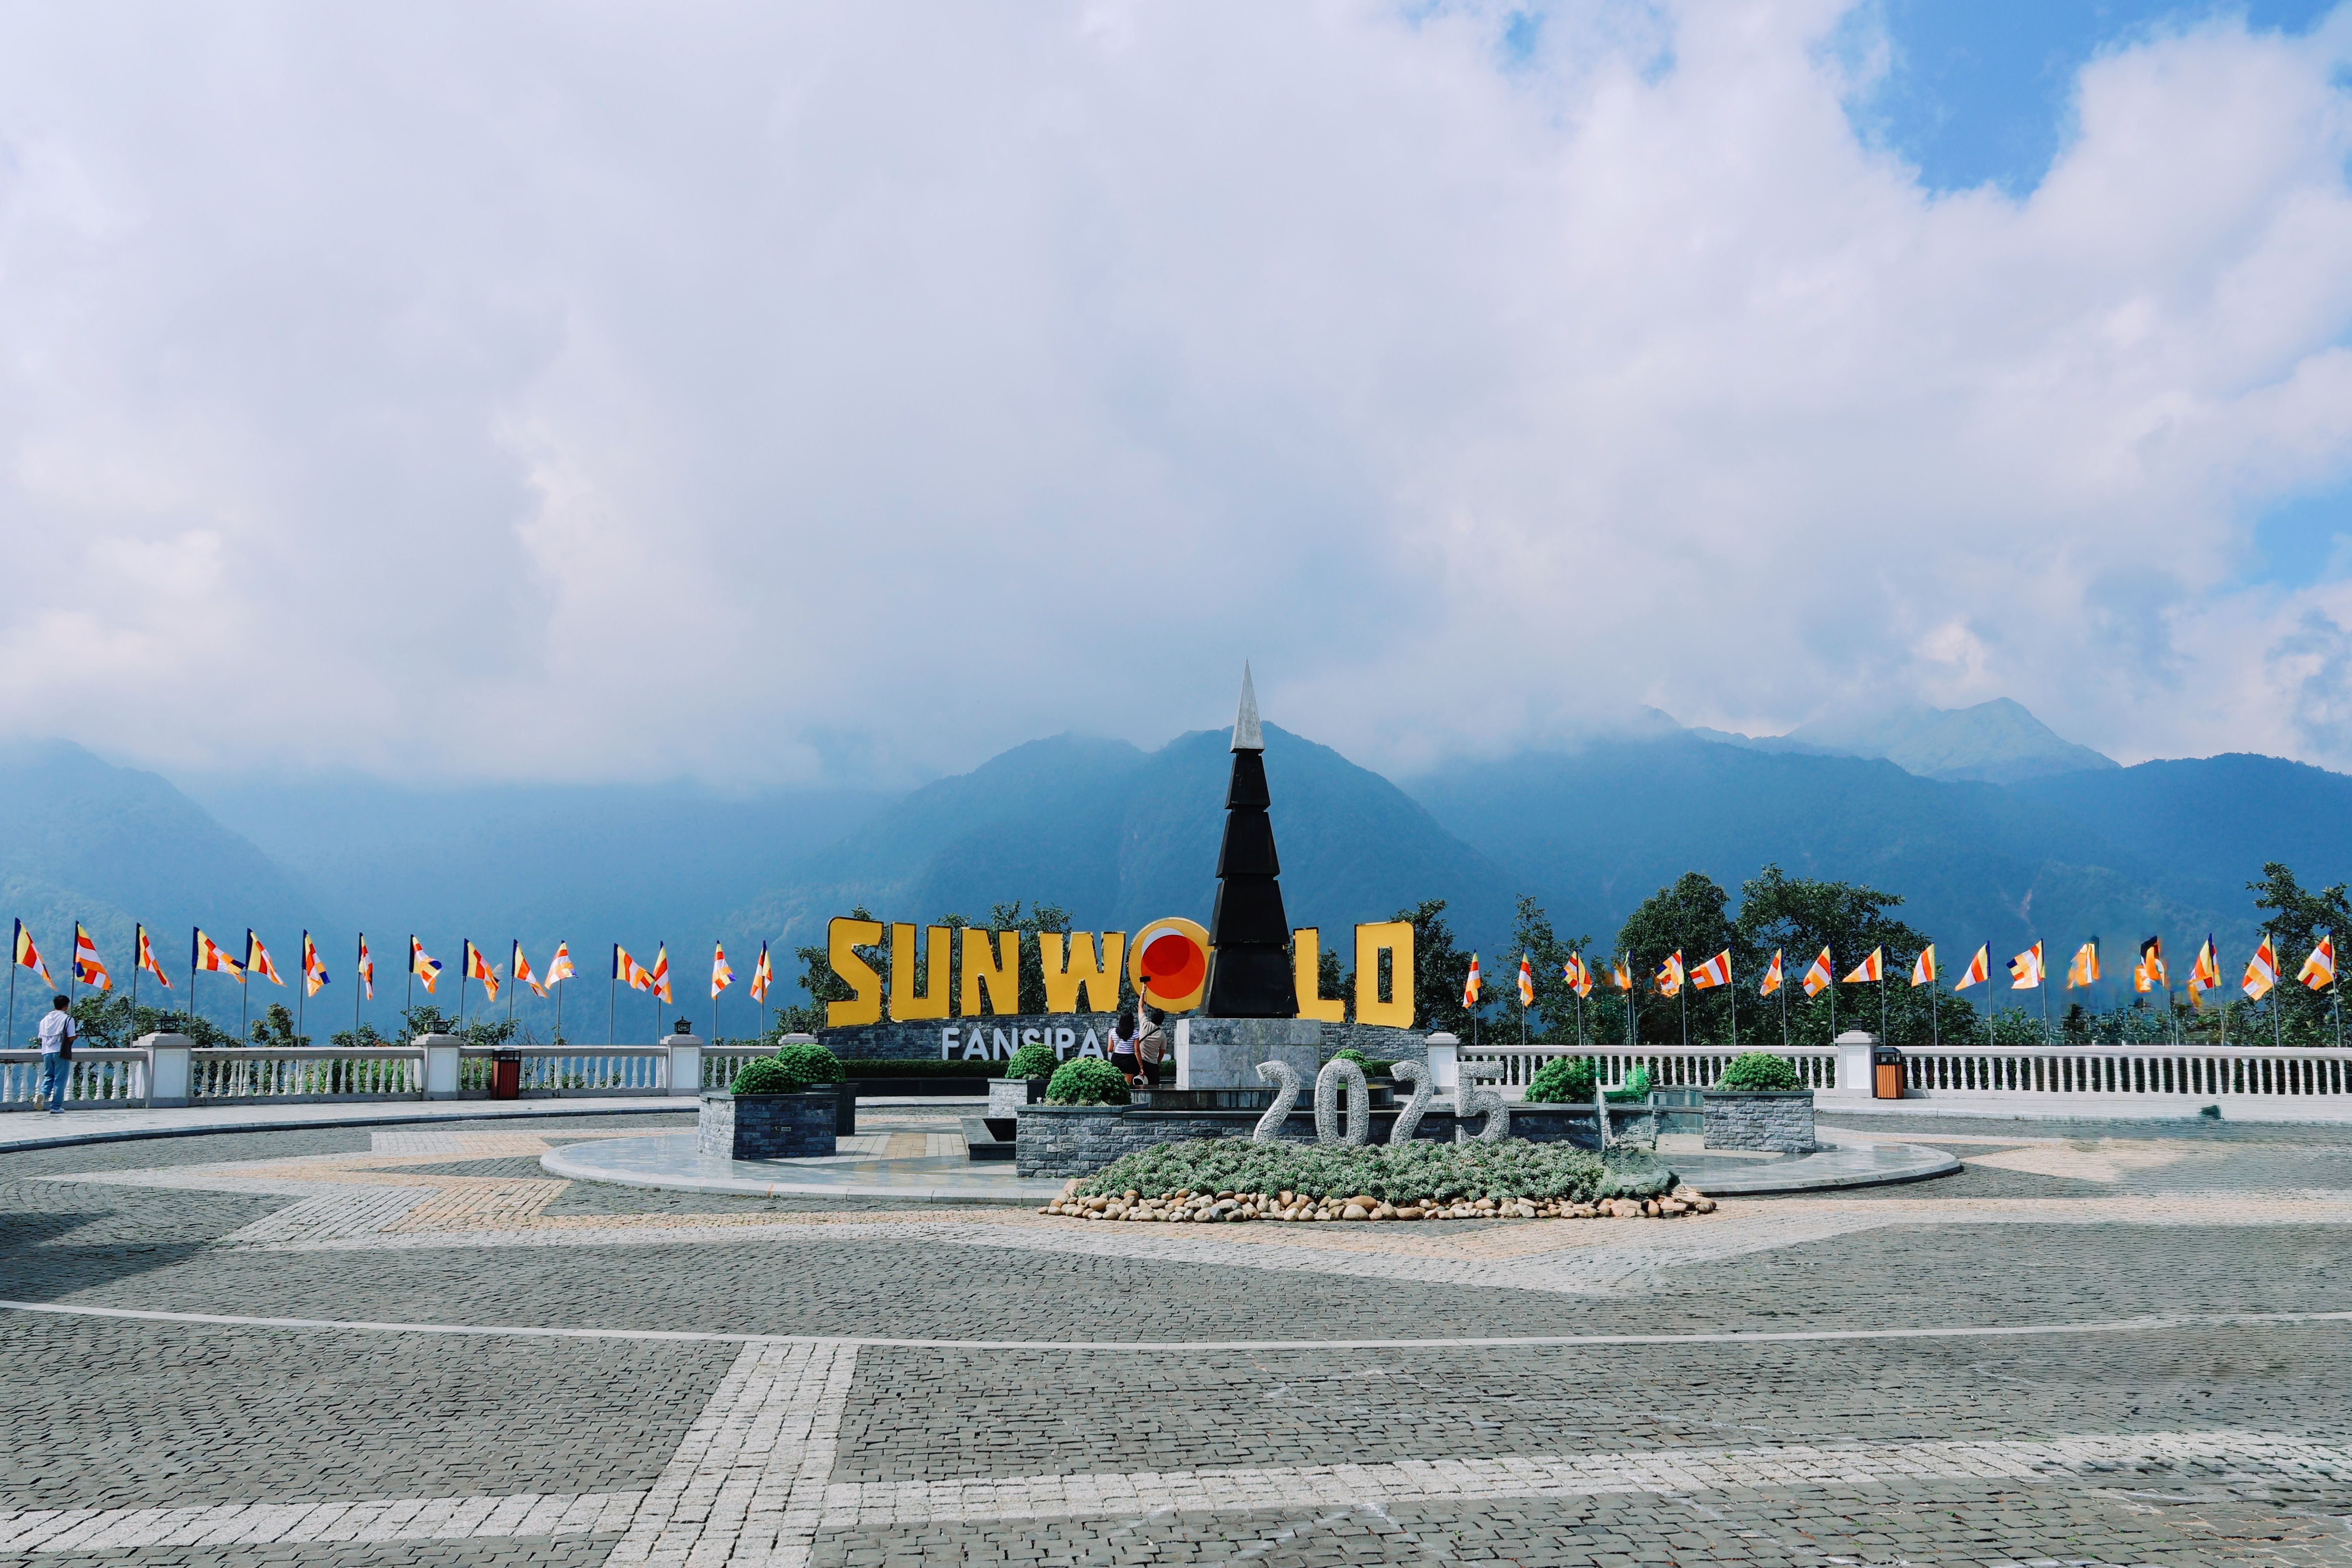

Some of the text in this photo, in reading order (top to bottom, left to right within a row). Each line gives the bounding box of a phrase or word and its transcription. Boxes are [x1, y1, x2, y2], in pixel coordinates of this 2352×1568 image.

[825, 916, 1414, 1029] SUN WOLD
[942, 1027, 1115, 1061] FANSIPA
[1253, 1059, 1510, 1146] 2025
